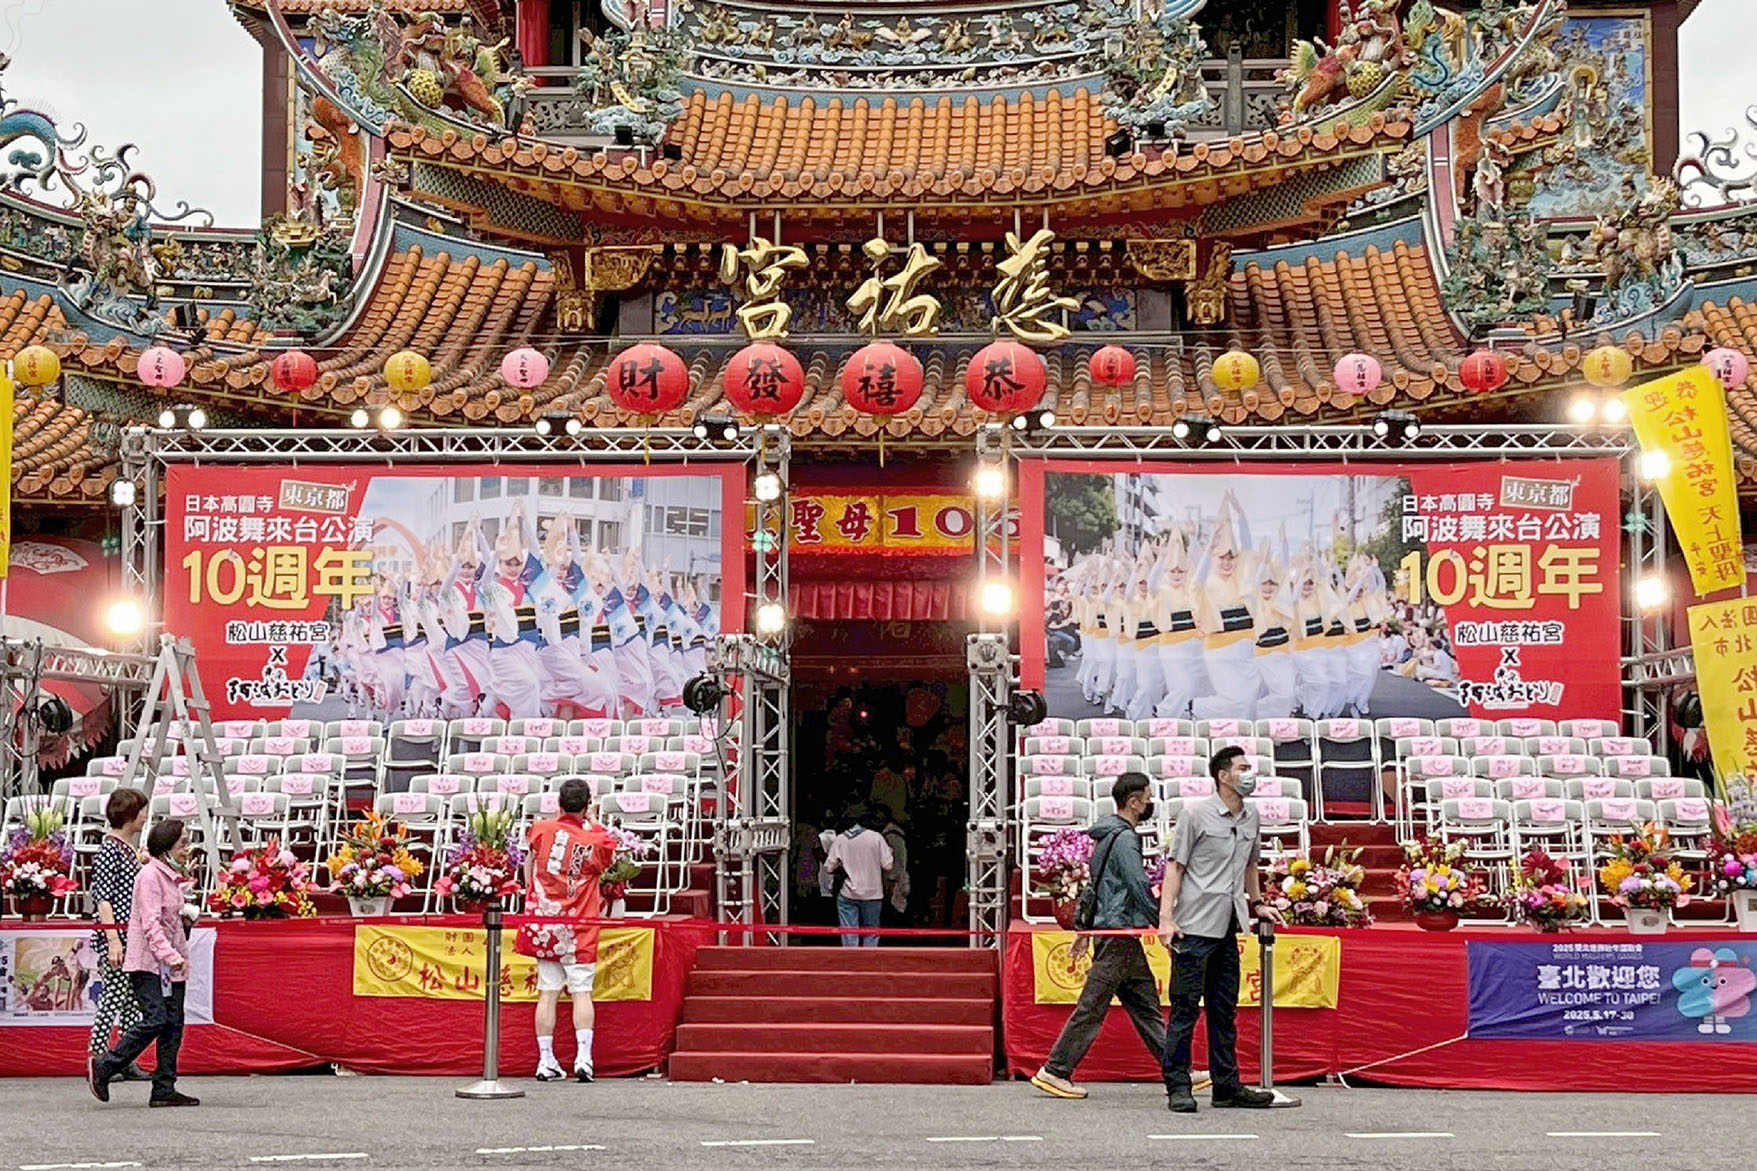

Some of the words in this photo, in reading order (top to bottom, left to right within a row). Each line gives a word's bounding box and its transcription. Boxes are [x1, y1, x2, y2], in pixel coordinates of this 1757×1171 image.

[618, 358, 664, 400] 財
[857, 363, 903, 407] 禧
[981, 356, 1025, 401] 恭
[186, 495, 275, 514] 日本高圓寺
[284, 484, 346, 511] 東京都
[1402, 493, 1496, 513] 日本高圓寺
[1505, 481, 1571, 507] 東京都
[183, 516, 376, 543] 阿波舞來台公演
[1401, 512, 1601, 543] 阿波舞來台公演
[182, 545, 377, 610] 10週年
[1400, 543, 1604, 610] 10週年
[227, 622, 329, 642] 松山慈祐宮
[1456, 621, 1562, 643] 松山慈祐宮
[1537, 964, 1660, 989] 臺北歡迎您
[1538, 992, 1602, 1005] WELCOME
[1604, 992, 1620, 1005] TO
[1624, 992, 1660, 1005] TAIPEI
